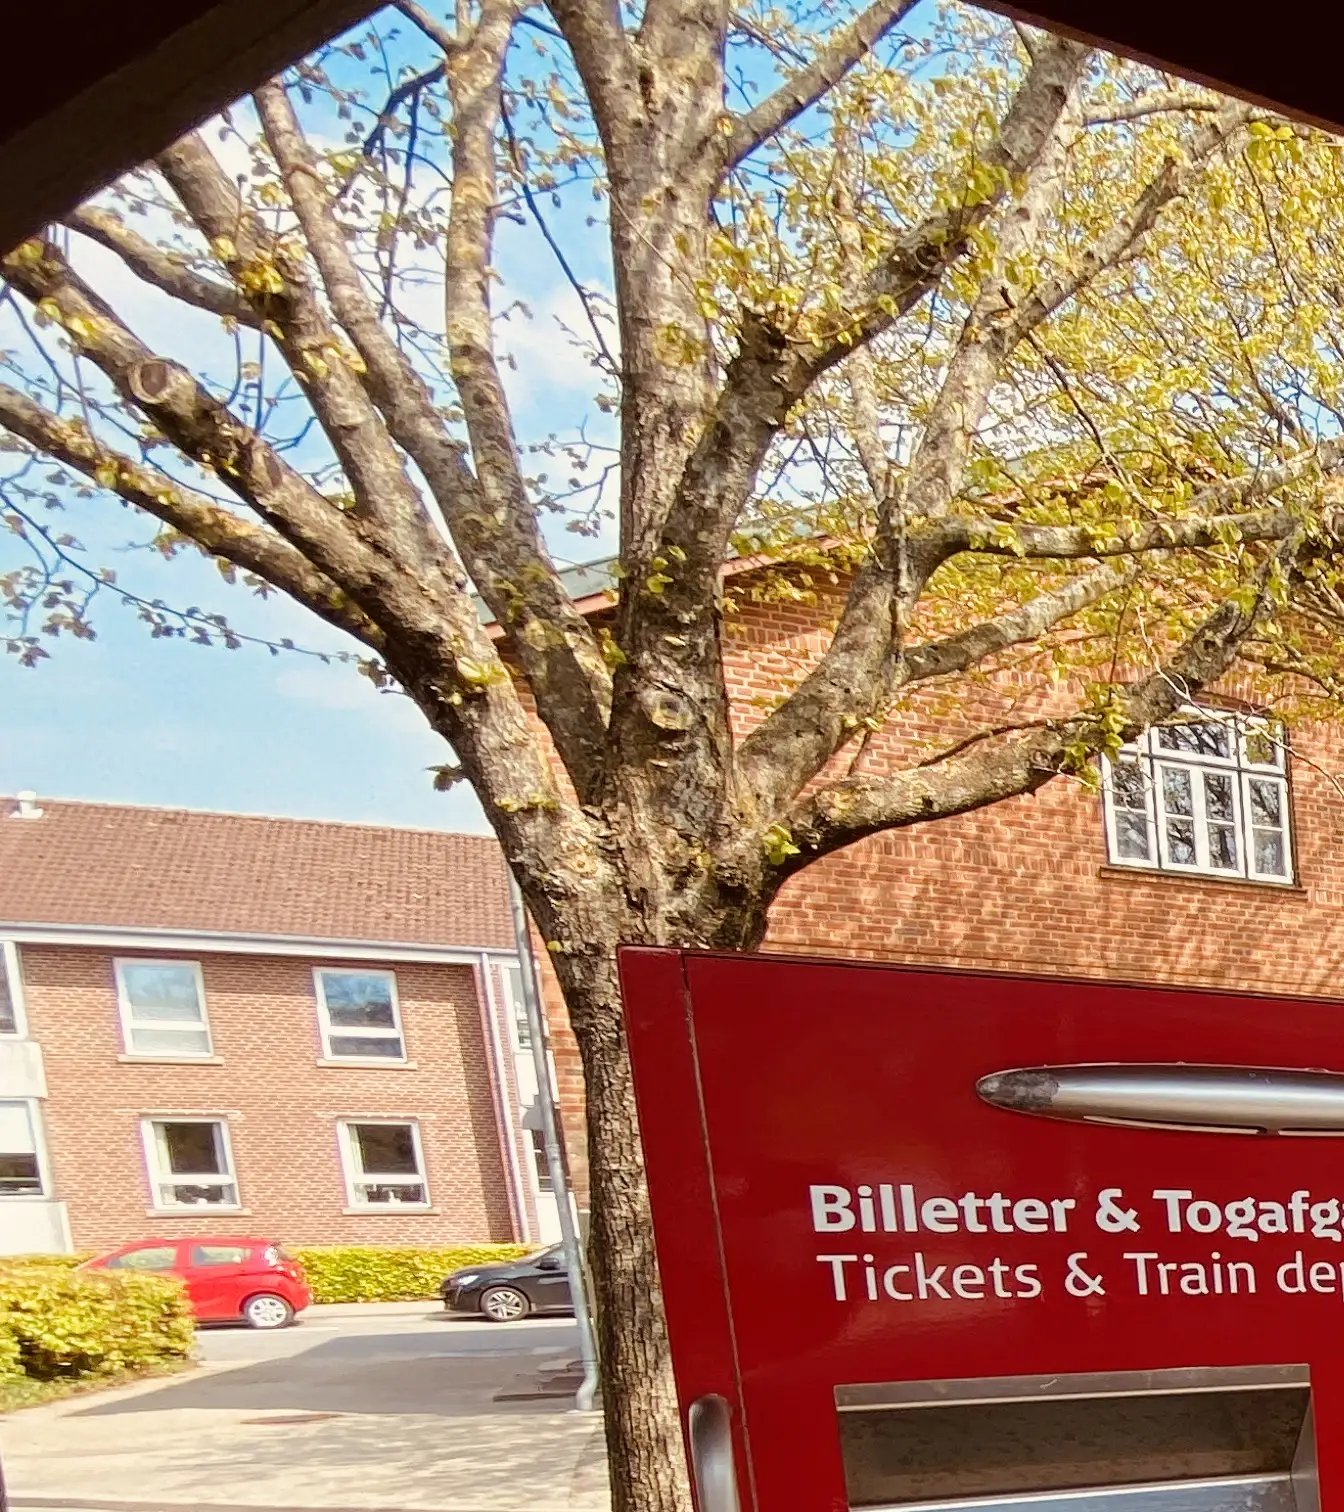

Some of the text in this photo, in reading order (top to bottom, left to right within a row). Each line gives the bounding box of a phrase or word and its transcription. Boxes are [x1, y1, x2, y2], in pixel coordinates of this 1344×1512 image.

[809, 1184, 1076, 1233] Billetter
[1095, 1188, 1141, 1233] &
[816, 1252, 1042, 1301] Tickets
[1065, 1252, 1106, 1297] &
[1123, 1252, 1257, 1296] Train
